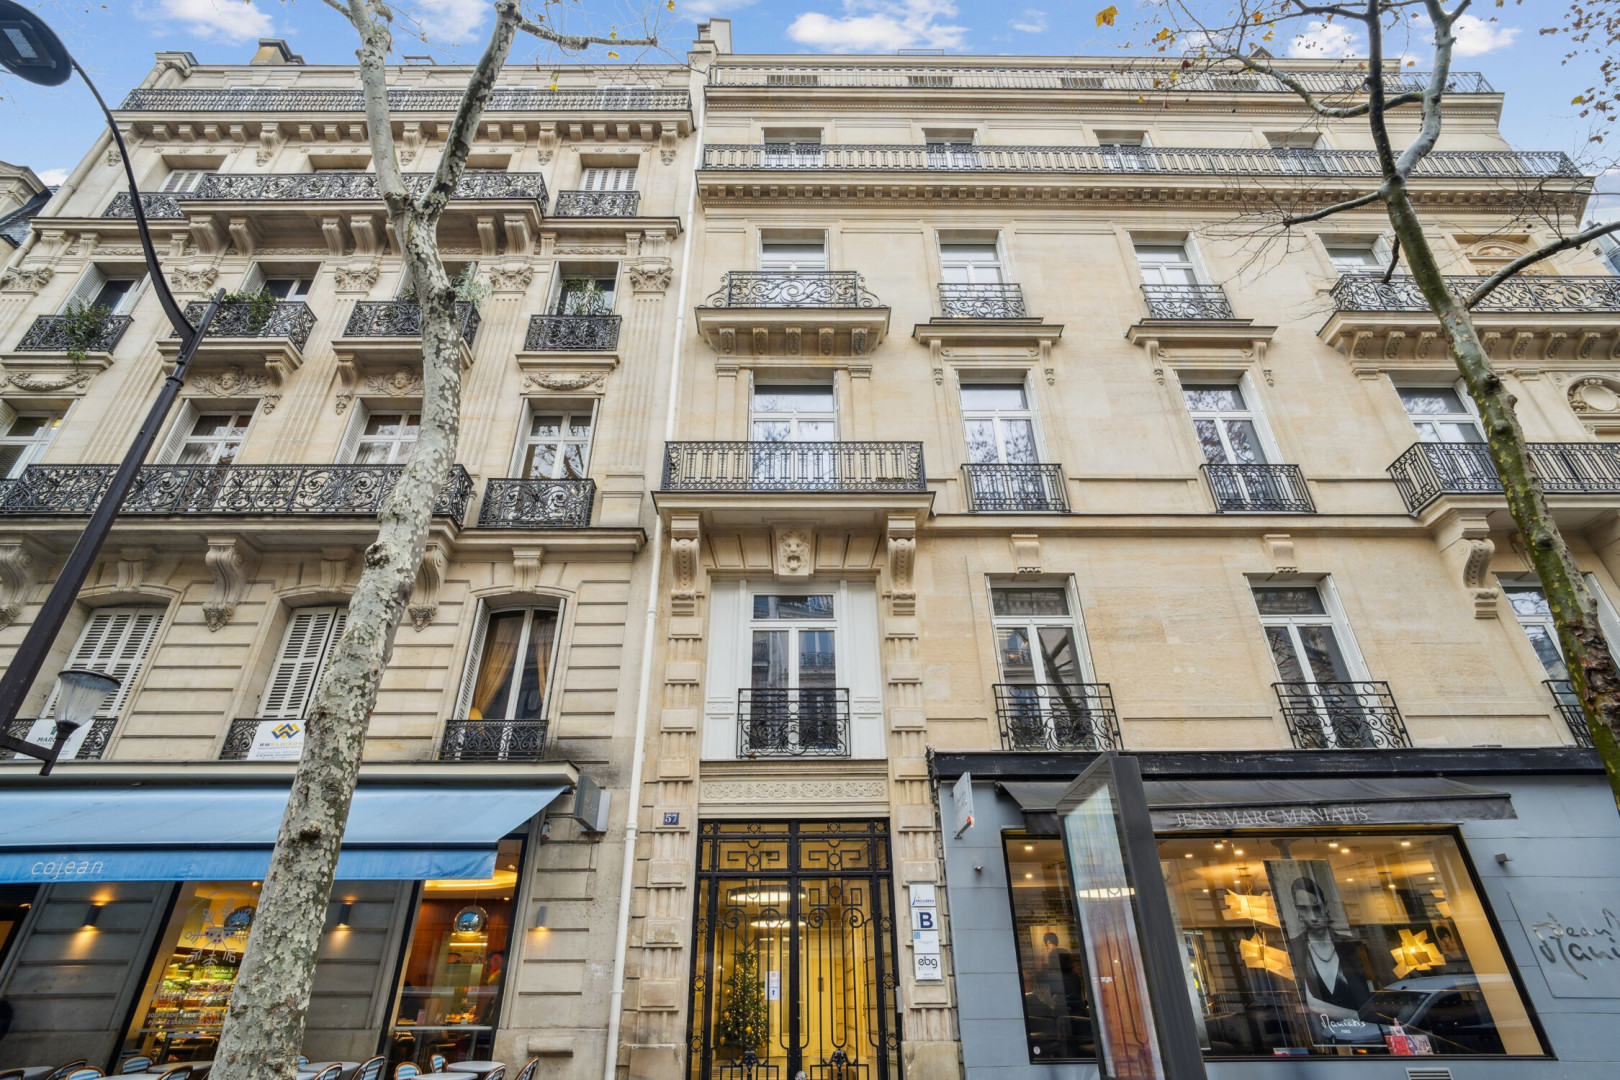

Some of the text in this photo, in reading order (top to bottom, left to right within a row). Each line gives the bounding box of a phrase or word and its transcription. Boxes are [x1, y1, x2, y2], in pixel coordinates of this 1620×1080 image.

[664, 814, 678, 823] 57
[1175, 806, 1369, 827] JEAN MARC MANIATIS
[31, 855, 104, 880] cojean
[919, 911, 933, 928] B
[918, 956, 938, 969] ebg
[1320, 1013, 1366, 1034] Maniatis
